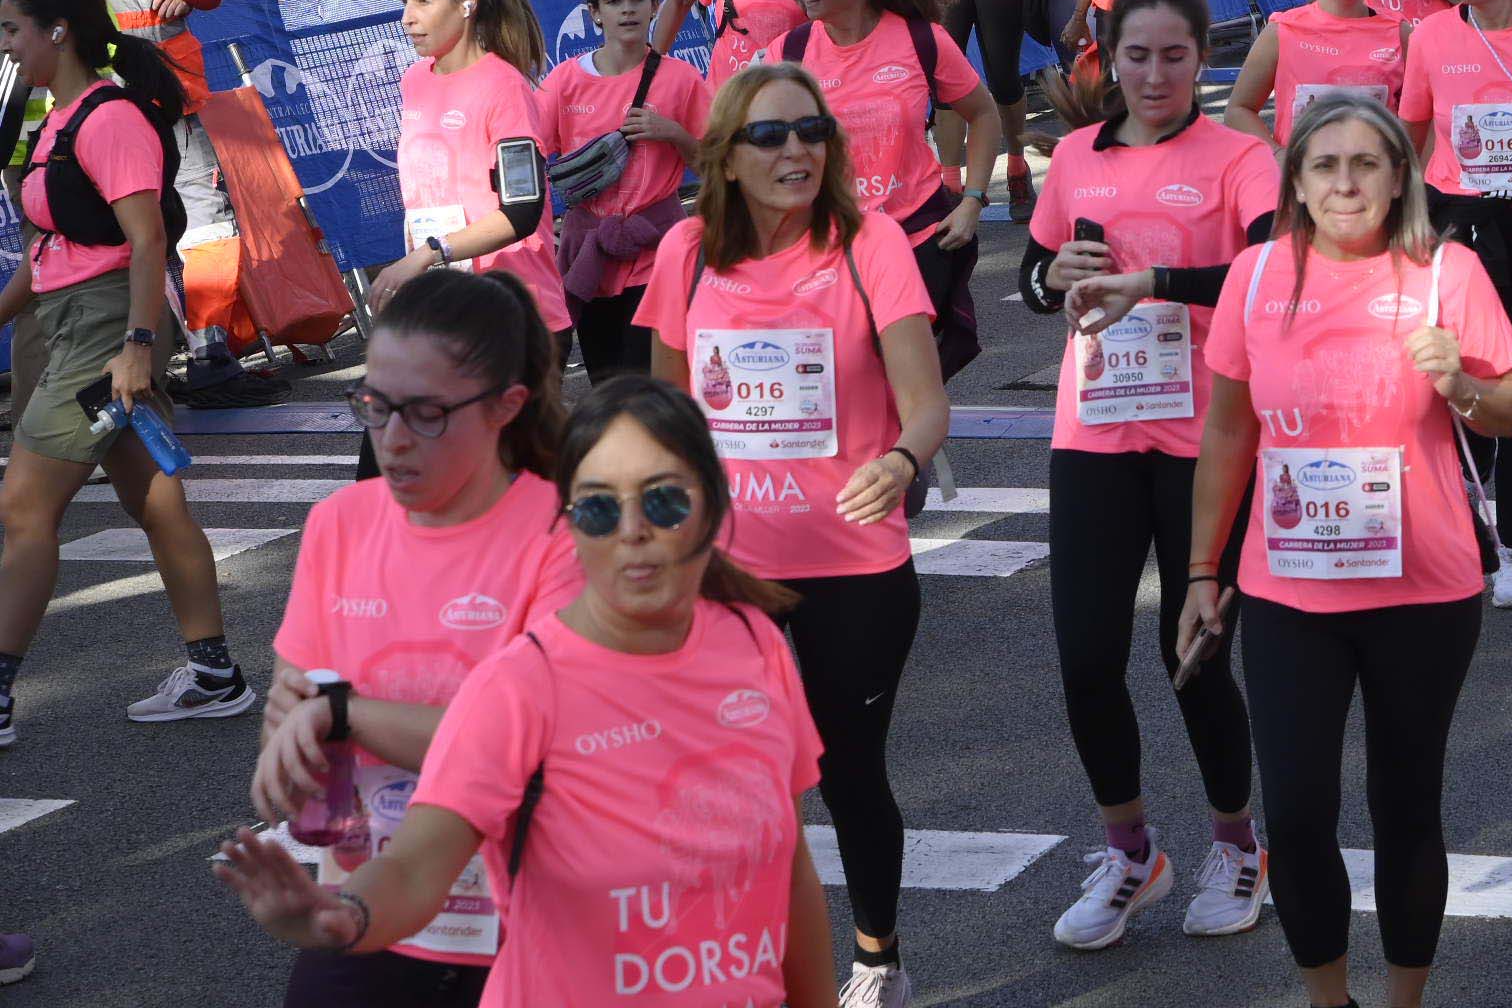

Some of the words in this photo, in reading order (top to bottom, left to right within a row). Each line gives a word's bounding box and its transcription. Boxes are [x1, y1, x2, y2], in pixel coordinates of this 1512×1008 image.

[1300, 42, 1340, 56] OYSHO
[1441, 63, 1482, 75] OYSHO
[817, 78, 842, 89] SHO
[856, 173, 900, 198] RSA
[1074, 186, 1118, 199] OYSHO
[1264, 298, 1321, 313] OYSHO
[795, 347, 823, 355] SUMA
[733, 352, 785, 364] ASTURIANA
[1107, 350, 1148, 369] 016
[1112, 372, 1144, 384] 30950
[737, 382, 784, 400] 016
[1087, 390, 1114, 399] CARRERA
[1114, 388, 1124, 396] DE
[1125, 387, 1135, 395] LA
[1136, 385, 1161, 395] MUJER
[1145, 399, 1184, 410] Santander
[745, 405, 775, 417] 4297
[711, 421, 744, 430] CARRERA
[745, 421, 757, 430] DE
[758, 421, 770, 430] LA
[771, 421, 800, 430] MUJER
[803, 421, 822, 430] 2023
[1260, 408, 1304, 438] TU
[781, 438, 826, 450] Santander
[1360, 463, 1389, 473] SUMA
[1300, 472, 1352, 483] ASTURIANA
[1305, 500, 1350, 519] 016
[1313, 524, 1341, 536] 4298
[1279, 541, 1312, 550] CARRERA
[1313, 541, 1323, 550] DE
[1324, 541, 1335, 550] LA
[1336, 541, 1366, 550] MUJER
[1367, 541, 1387, 549] 2023
[1278, 558, 1314, 569] OYSHO
[1345, 558, 1390, 569] Santander
[575, 719, 663, 756] OYSHO
[609, 882, 671, 933] TU
[426, 925, 483, 938] antander
[615, 922, 788, 996] DORSA
